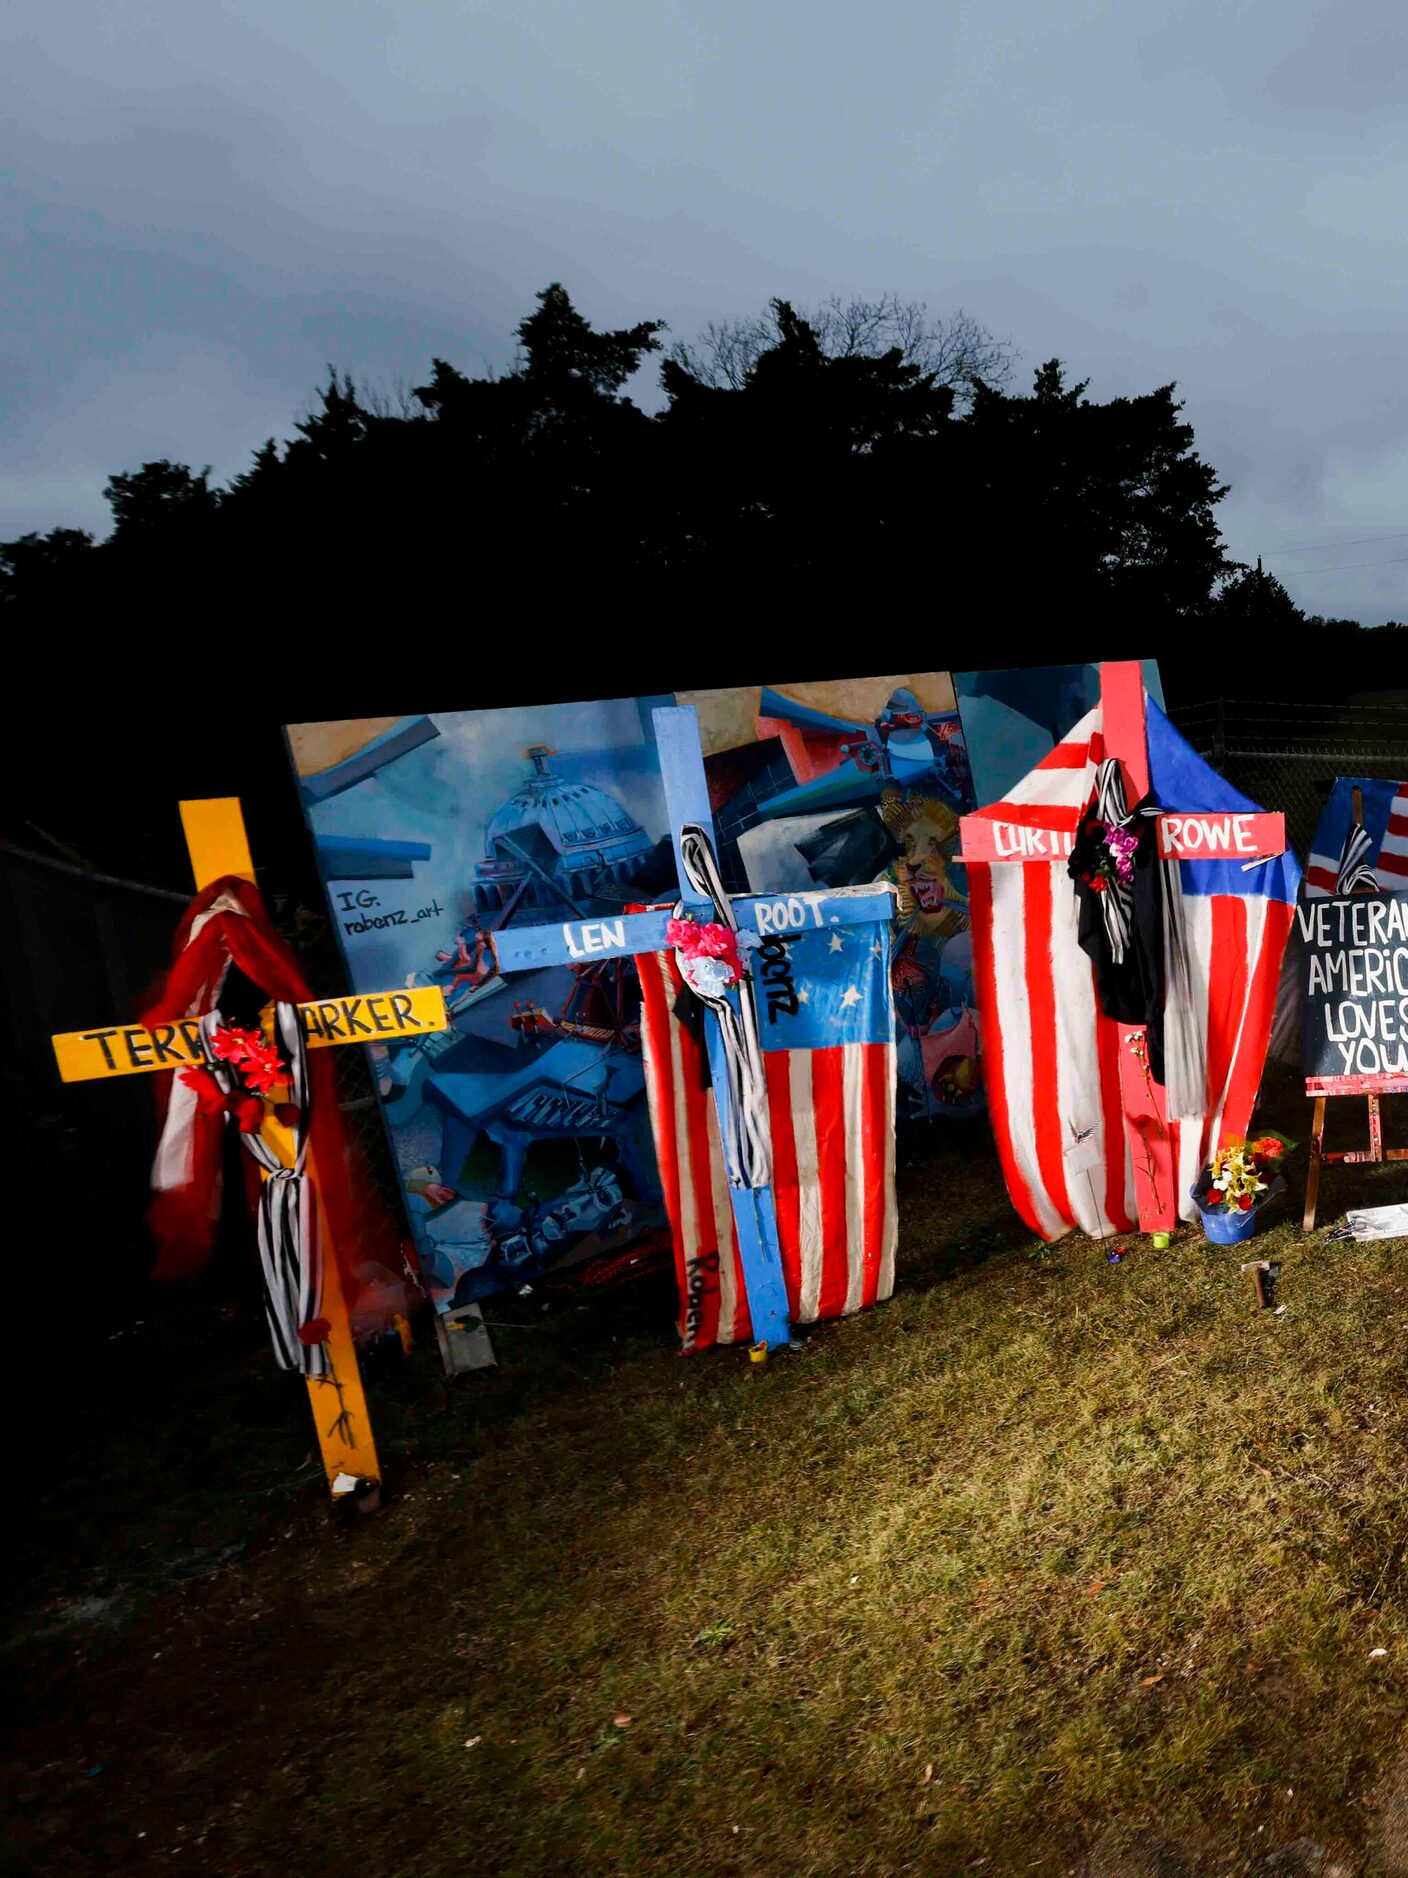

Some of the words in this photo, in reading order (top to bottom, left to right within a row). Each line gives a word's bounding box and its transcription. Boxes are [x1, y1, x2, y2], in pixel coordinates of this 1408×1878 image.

[992, 821, 1076, 857] CURTI
[1161, 814, 1257, 853] ROWE
[562, 920, 626, 959] LEN
[754, 896, 840, 937] ROOT.
